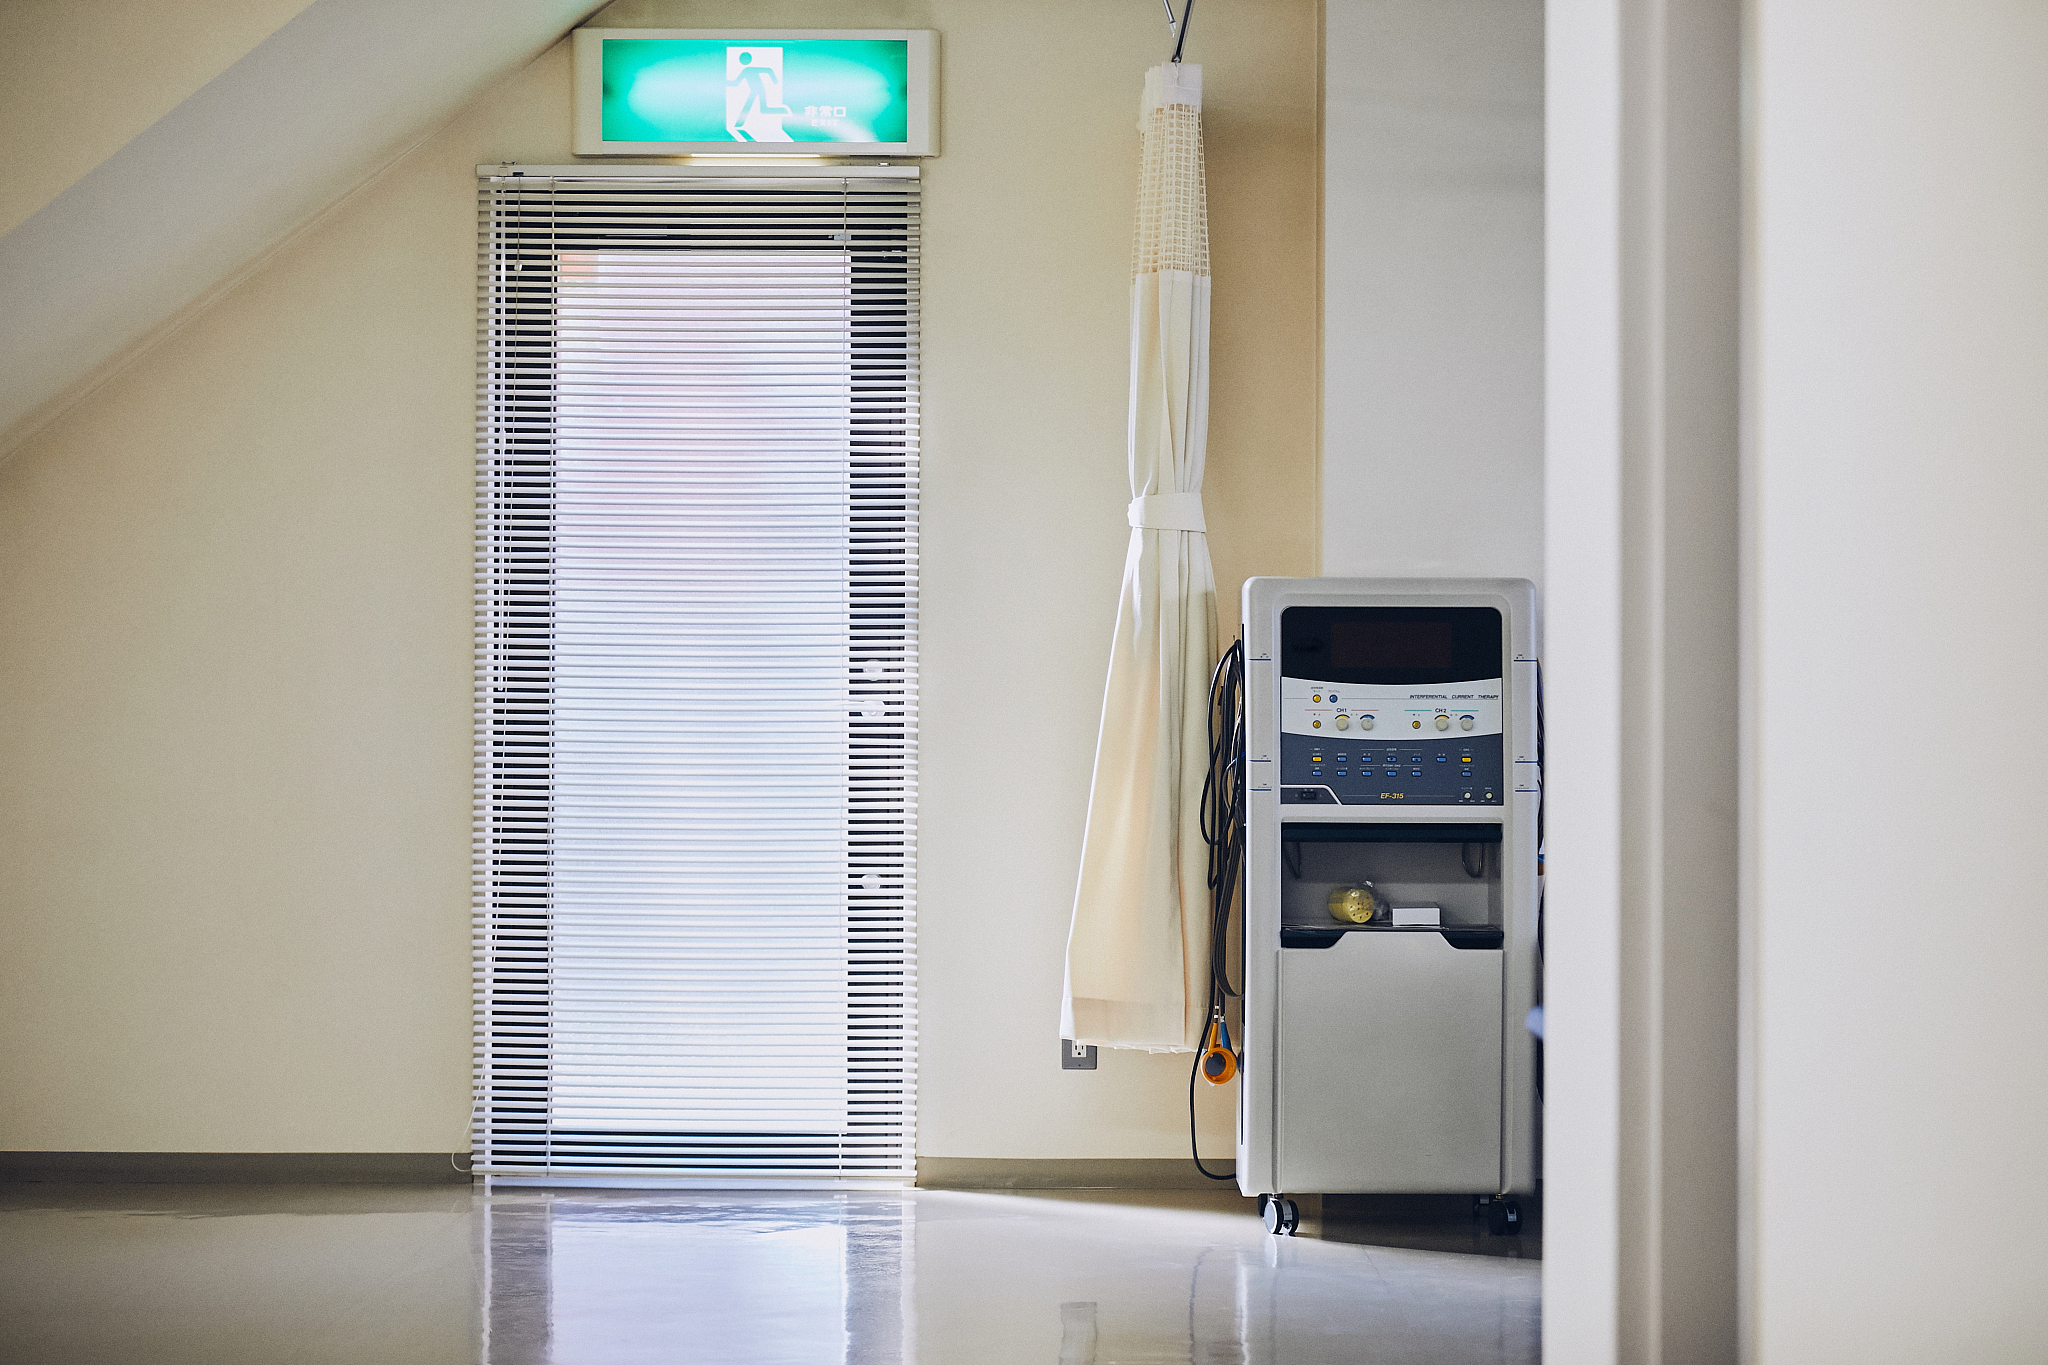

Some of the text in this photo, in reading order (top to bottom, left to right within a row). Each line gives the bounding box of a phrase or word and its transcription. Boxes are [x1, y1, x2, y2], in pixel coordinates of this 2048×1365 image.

[804, 105, 847, 117] 非常口
[811, 119, 840, 127] EXIT
